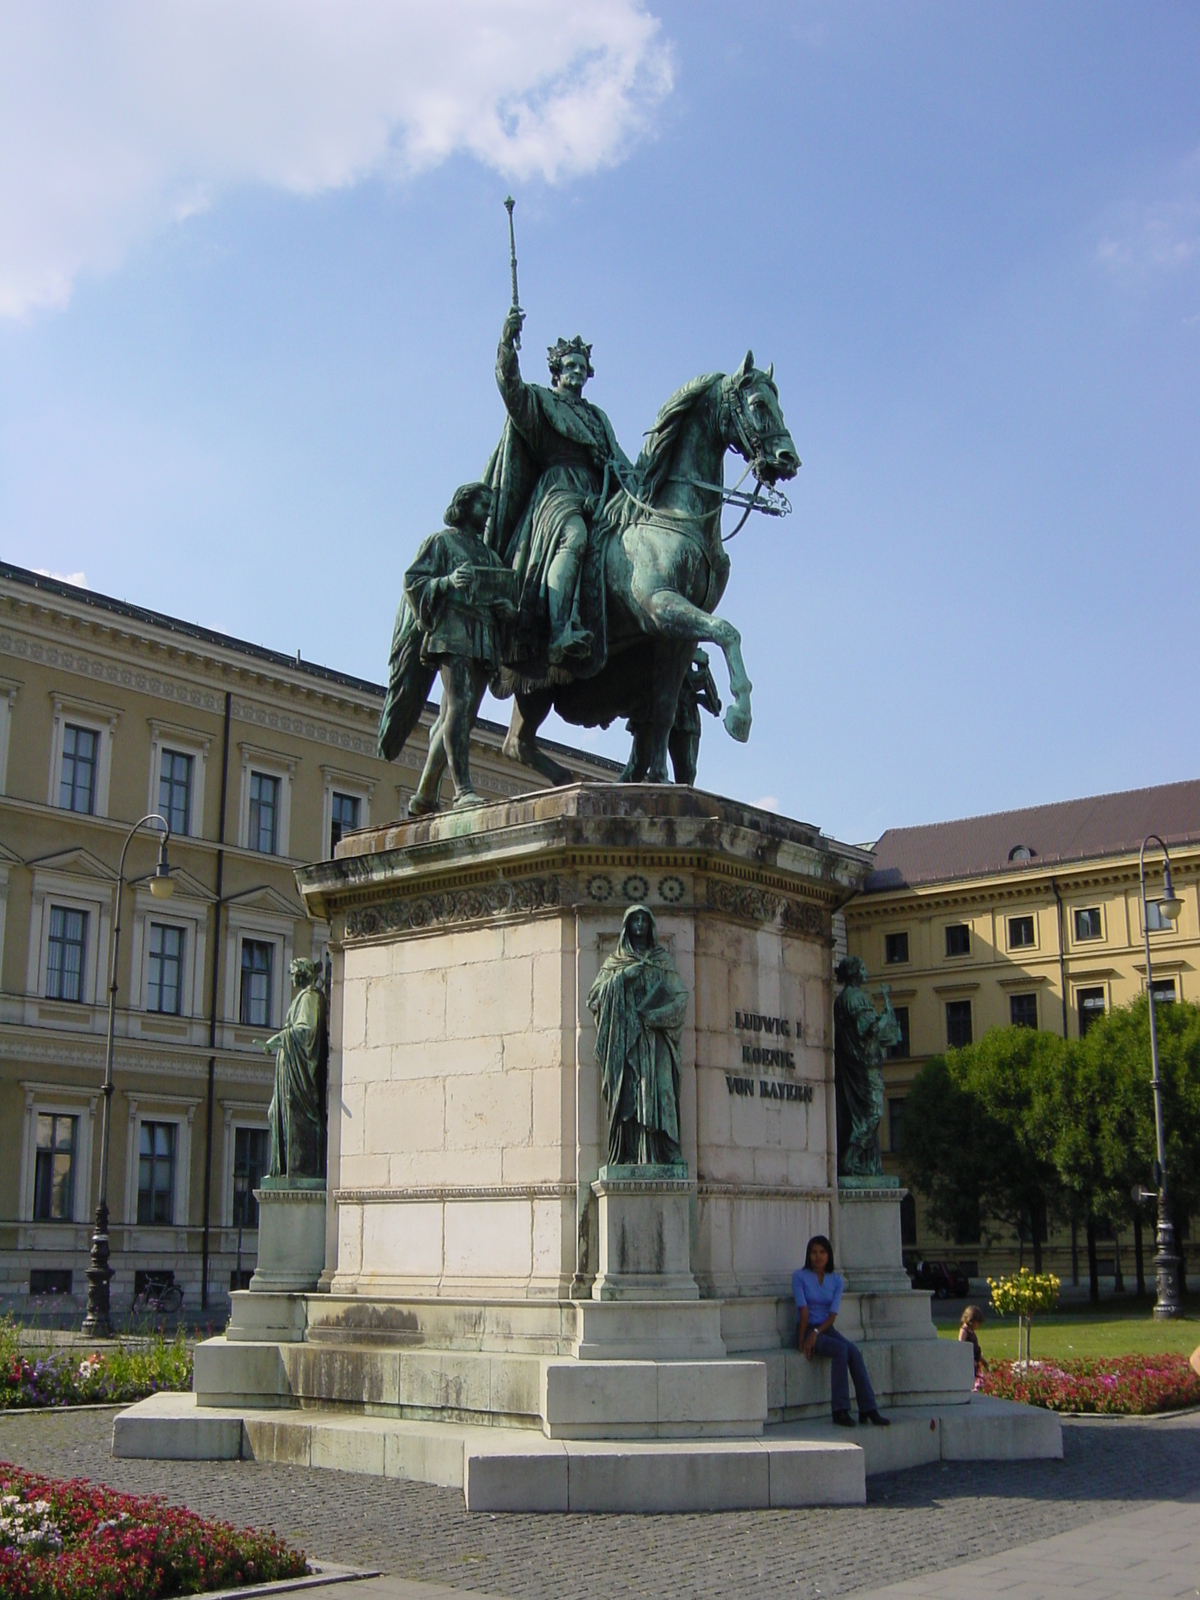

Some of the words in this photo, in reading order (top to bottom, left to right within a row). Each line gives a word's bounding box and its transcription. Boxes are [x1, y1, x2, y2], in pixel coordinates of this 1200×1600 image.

[735, 1011, 790, 1037] LUDWIG
[796, 1021, 802, 1038] I
[742, 1045, 796, 1069] KOENIG
[725, 1076, 754, 1097] VON
[760, 1080, 812, 1102] BAYERN
